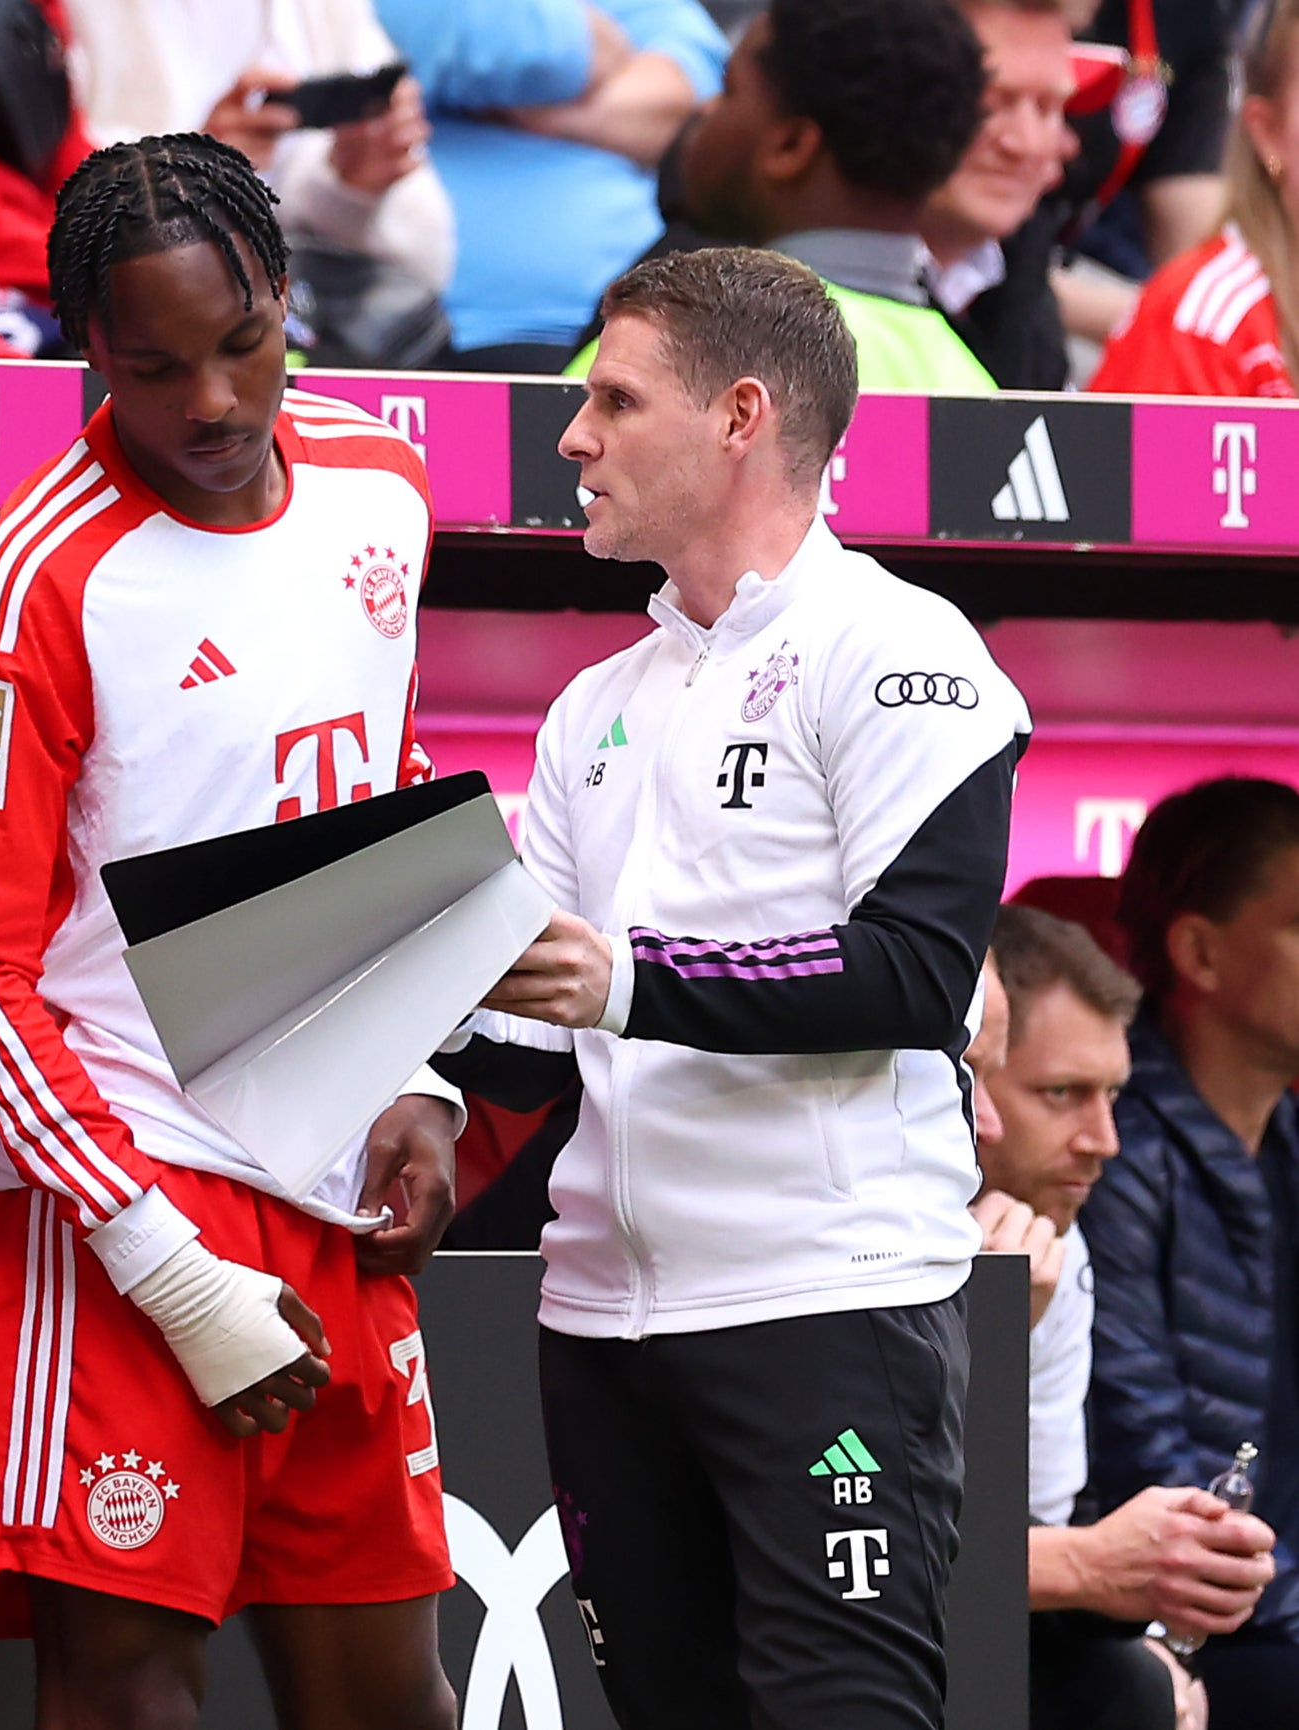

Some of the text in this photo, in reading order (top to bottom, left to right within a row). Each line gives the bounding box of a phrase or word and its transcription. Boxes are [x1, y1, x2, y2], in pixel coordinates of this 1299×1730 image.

[1213, 421, 1257, 528] T
[716, 743, 768, 809] T
[96, 1478, 158, 1509] FC BAYERN
[833, 1476, 872, 1505] AB
[825, 1528, 890, 1600] T
